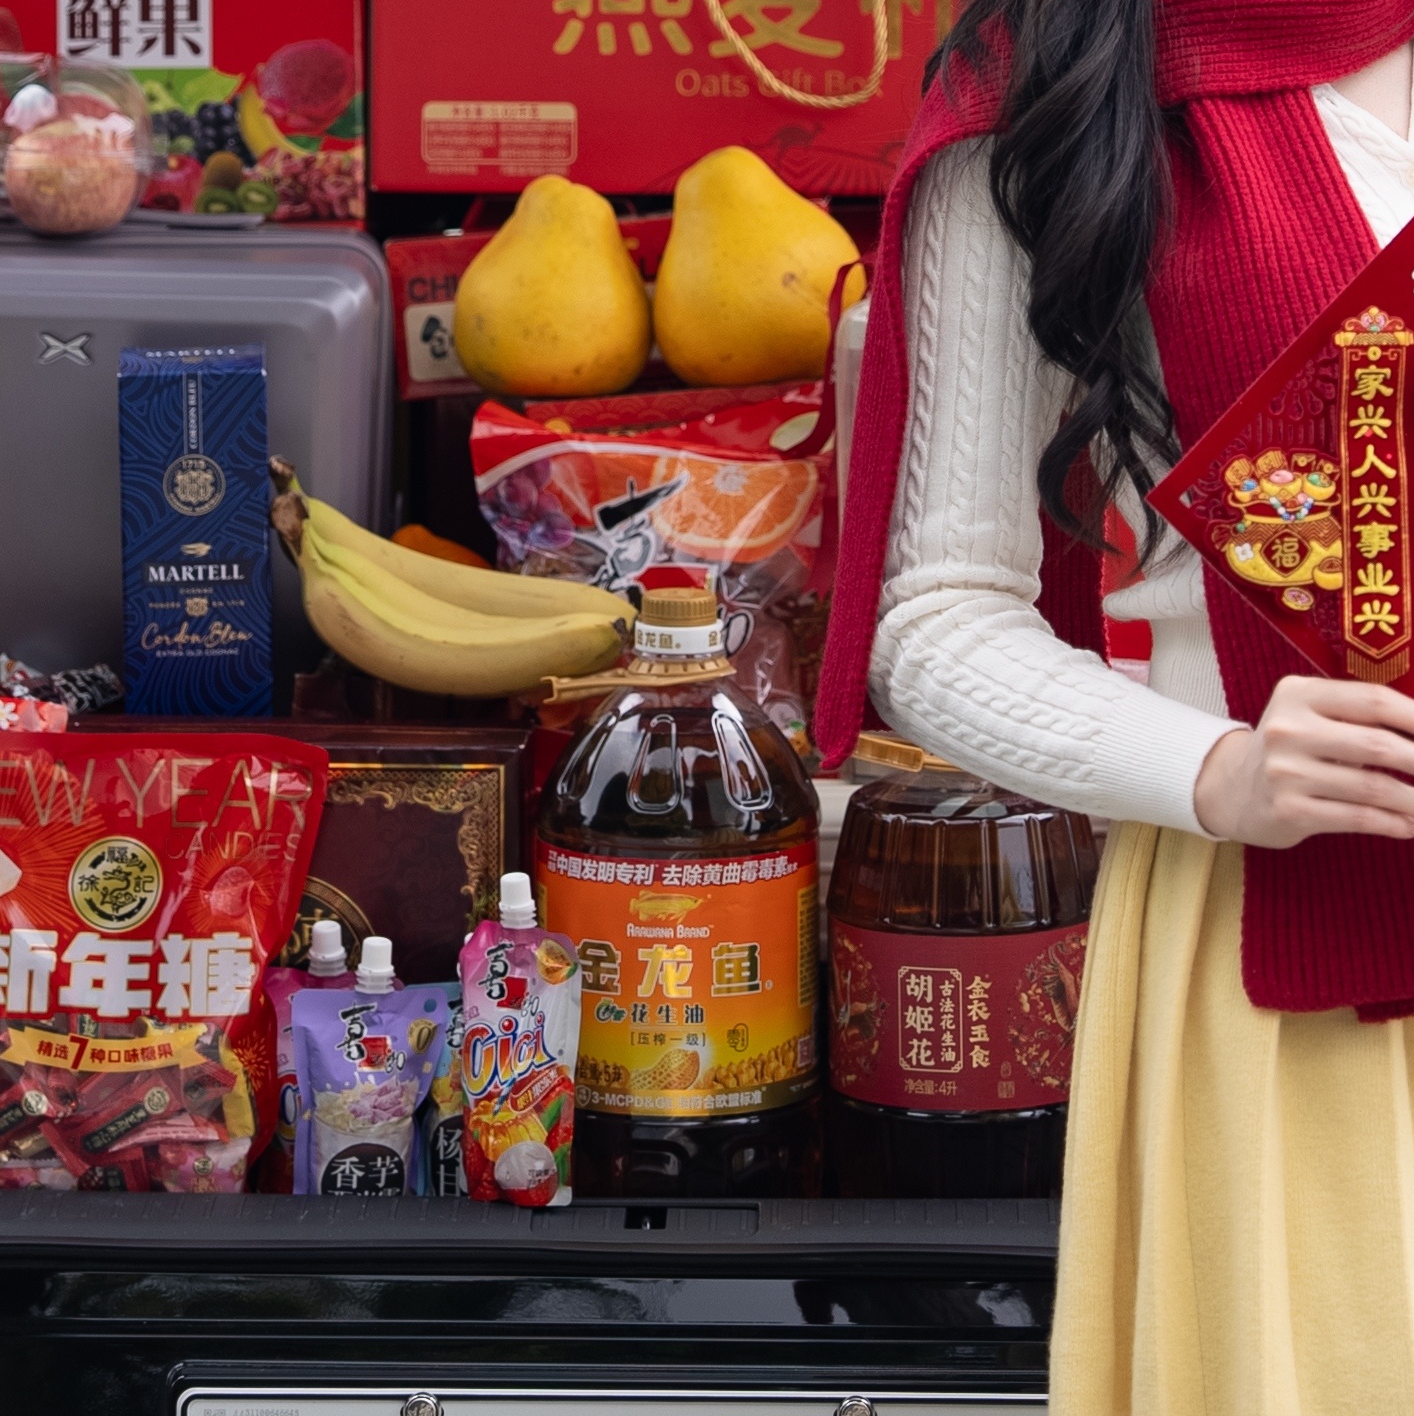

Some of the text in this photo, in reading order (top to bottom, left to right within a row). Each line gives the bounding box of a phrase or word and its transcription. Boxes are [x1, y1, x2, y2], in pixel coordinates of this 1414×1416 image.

[675, 68, 750, 97] Oats
[1348, 364, 1401, 637] 家兴人兴事业兴
[1271, 537, 1301, 569] 福
[148, 564, 245, 582] MARTELL
[116, 754, 315, 831] YEAR
[165, 827, 302, 863] CANDIES
[556, 854, 654, 885] 中国发明专利
[576, 938, 763, 999] 金龙鱼
[632, 1002, 705, 1025] 花生油
[904, 973, 935, 1066] 胡姬花
[939, 980, 956, 1063] 古法花生油
[966, 975, 992, 1068] 金衣玉食
[36, 1036, 174, 1070] 精选7种口味糖果
[905, 1079, 957, 1096] 净含量:4升
[330, 1155, 400, 1189] 香芋
